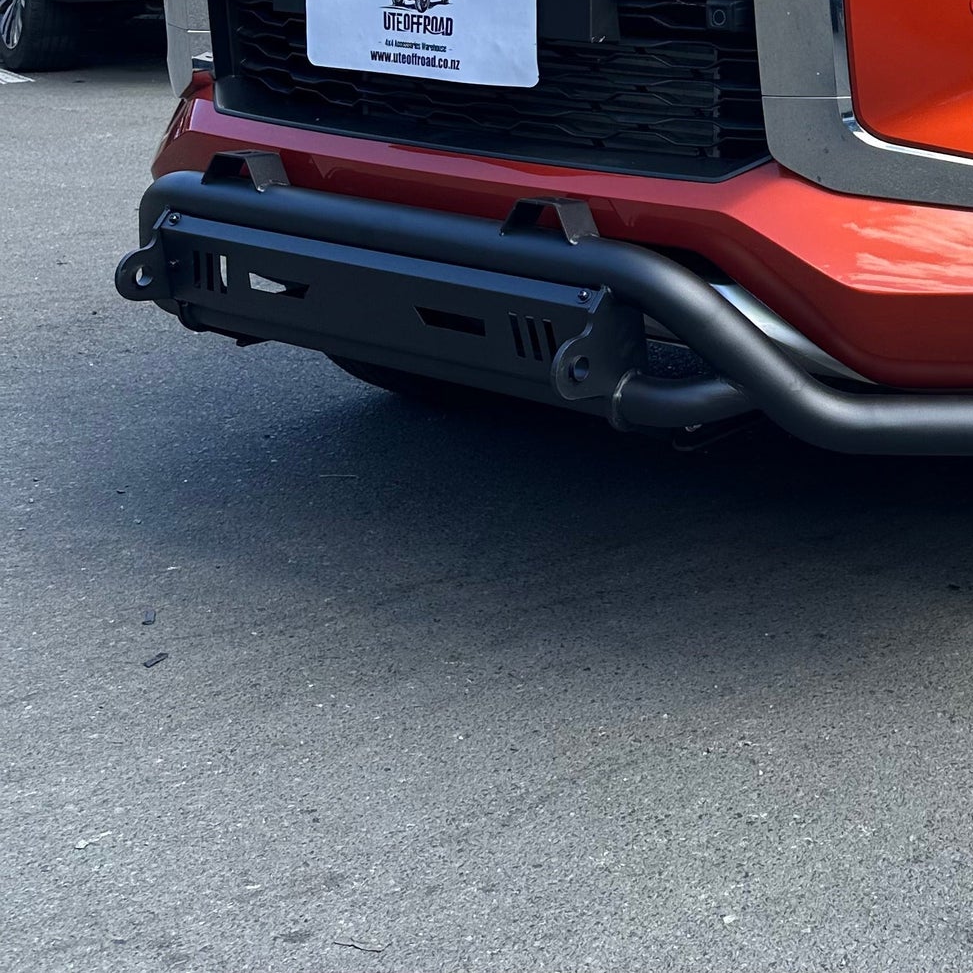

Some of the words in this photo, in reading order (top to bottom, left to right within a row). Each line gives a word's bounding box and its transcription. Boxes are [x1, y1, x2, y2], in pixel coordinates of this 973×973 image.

[395, 39, 421, 50] Accessories
[422, 42, 447, 53] Warehouse
[370, 50, 461, 71] www.uteoffroad.co.nz
